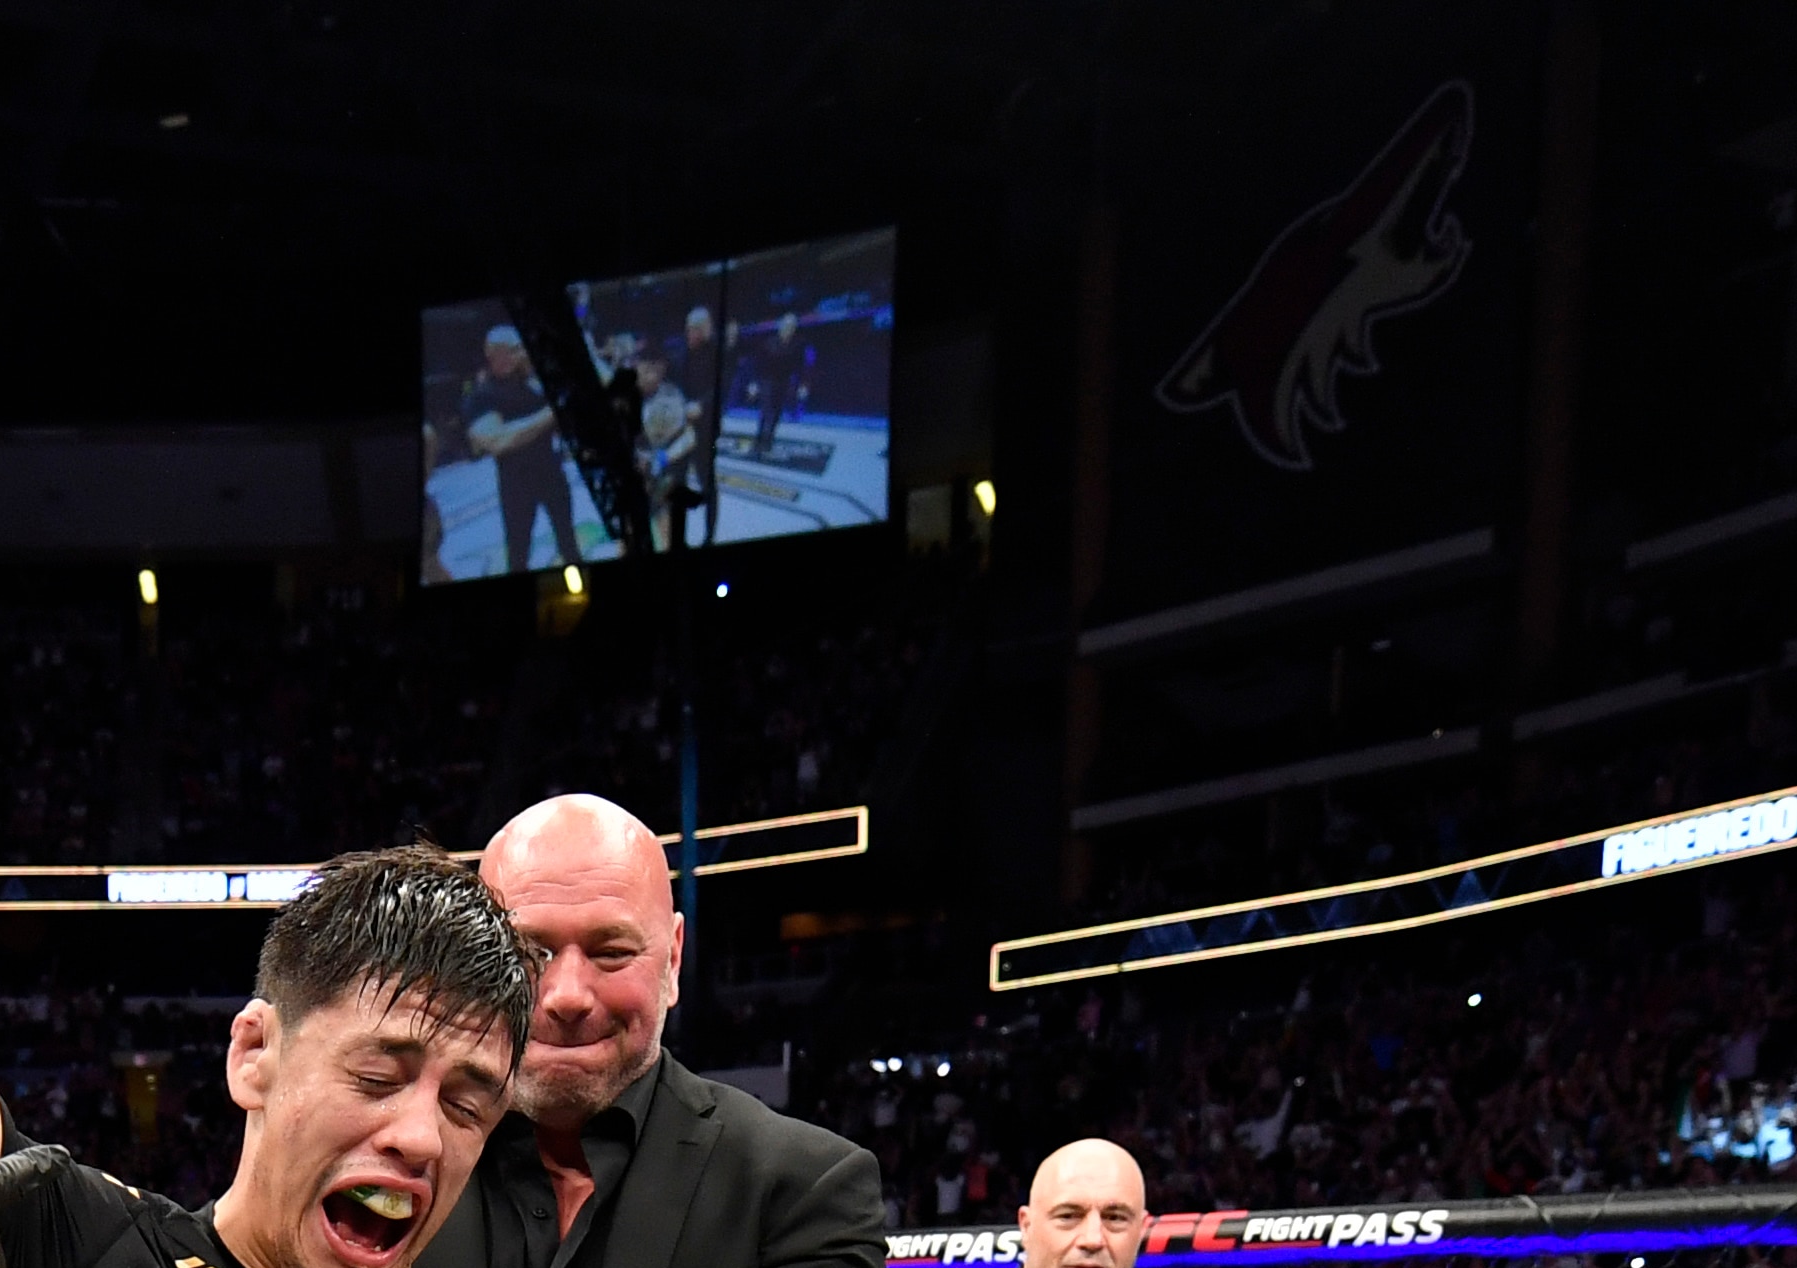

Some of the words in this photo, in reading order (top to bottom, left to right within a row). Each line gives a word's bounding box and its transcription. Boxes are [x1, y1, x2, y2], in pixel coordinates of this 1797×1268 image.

[942, 1231, 1026, 1265] PAS
[1144, 1210, 1249, 1253] FC
[1242, 1214, 1334, 1242] FIGHT
[1327, 1210, 1450, 1248] PASS
